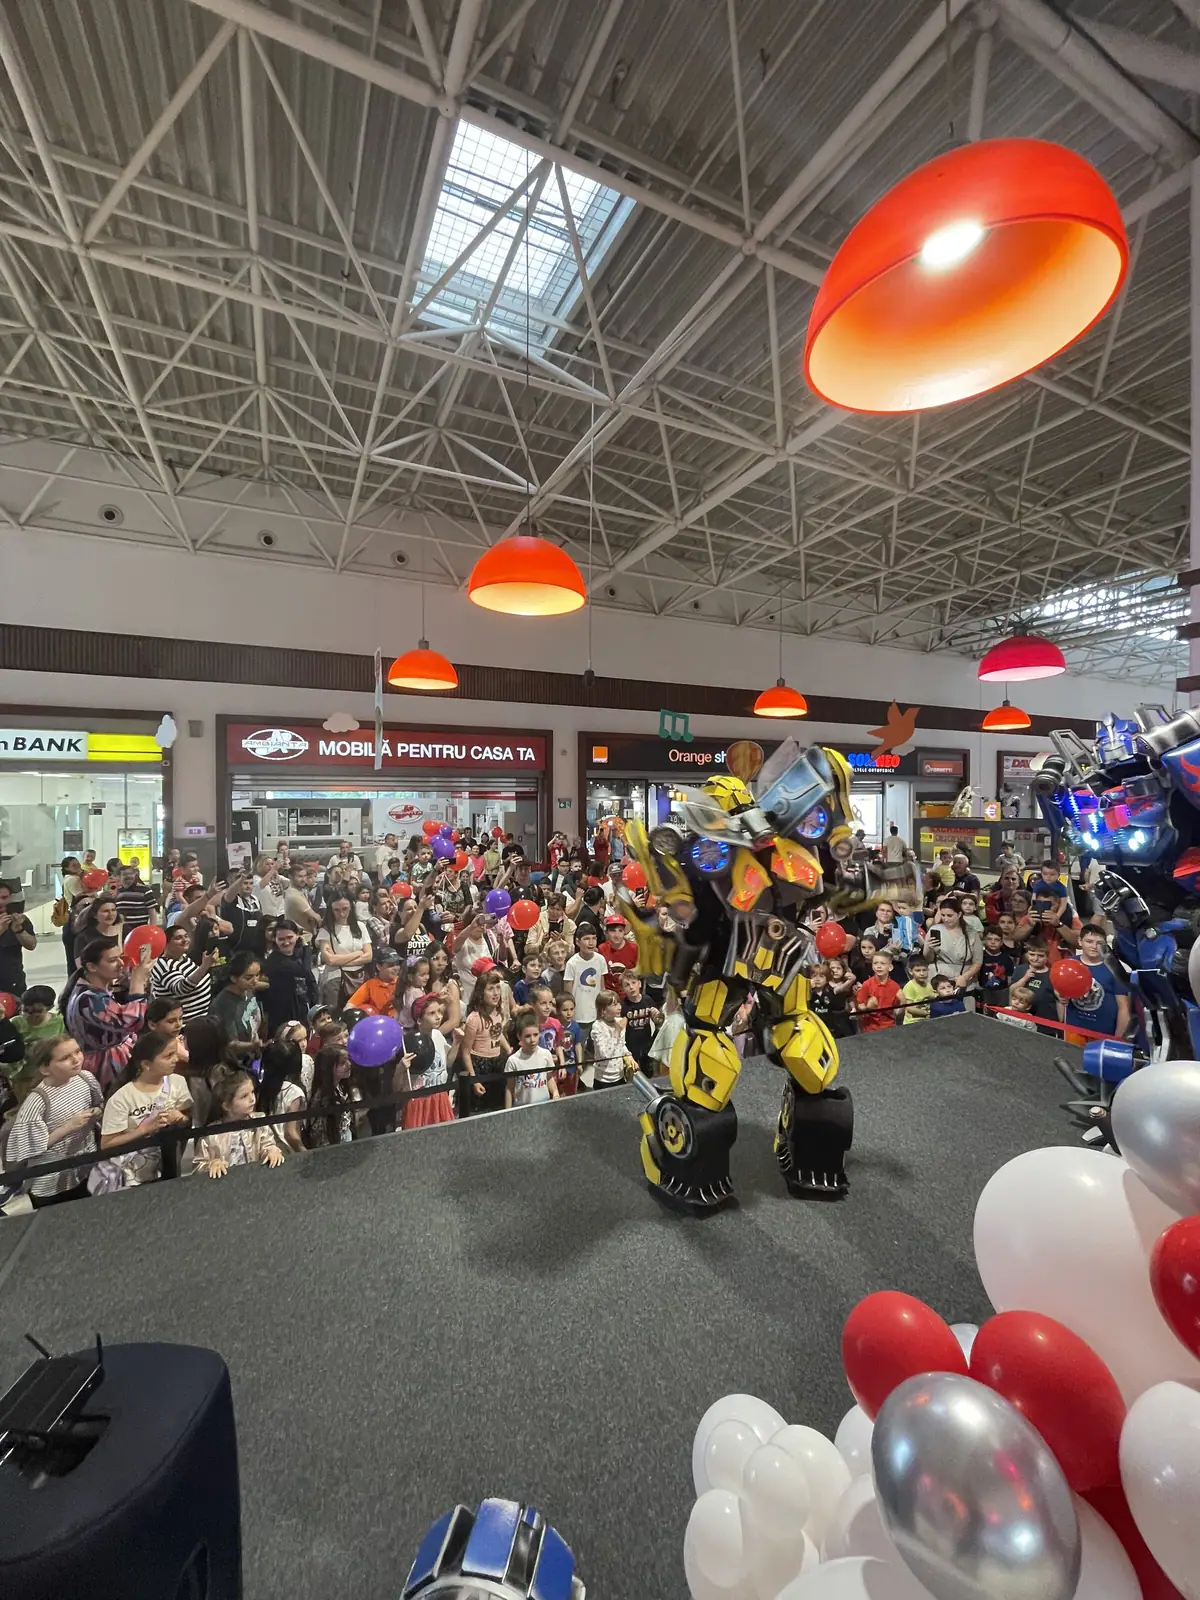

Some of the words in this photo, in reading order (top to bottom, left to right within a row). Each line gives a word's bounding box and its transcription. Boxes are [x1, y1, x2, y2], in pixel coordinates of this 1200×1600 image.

[13, 736, 83, 752] BANK
[318, 739, 392, 757] MOBILĂ
[397, 743, 467, 760] PENTRU
[470, 745, 514, 761] CASA
[517, 747, 536, 761] TA
[668, 749, 712, 766] Orange
[714, 750, 727, 764] sh
